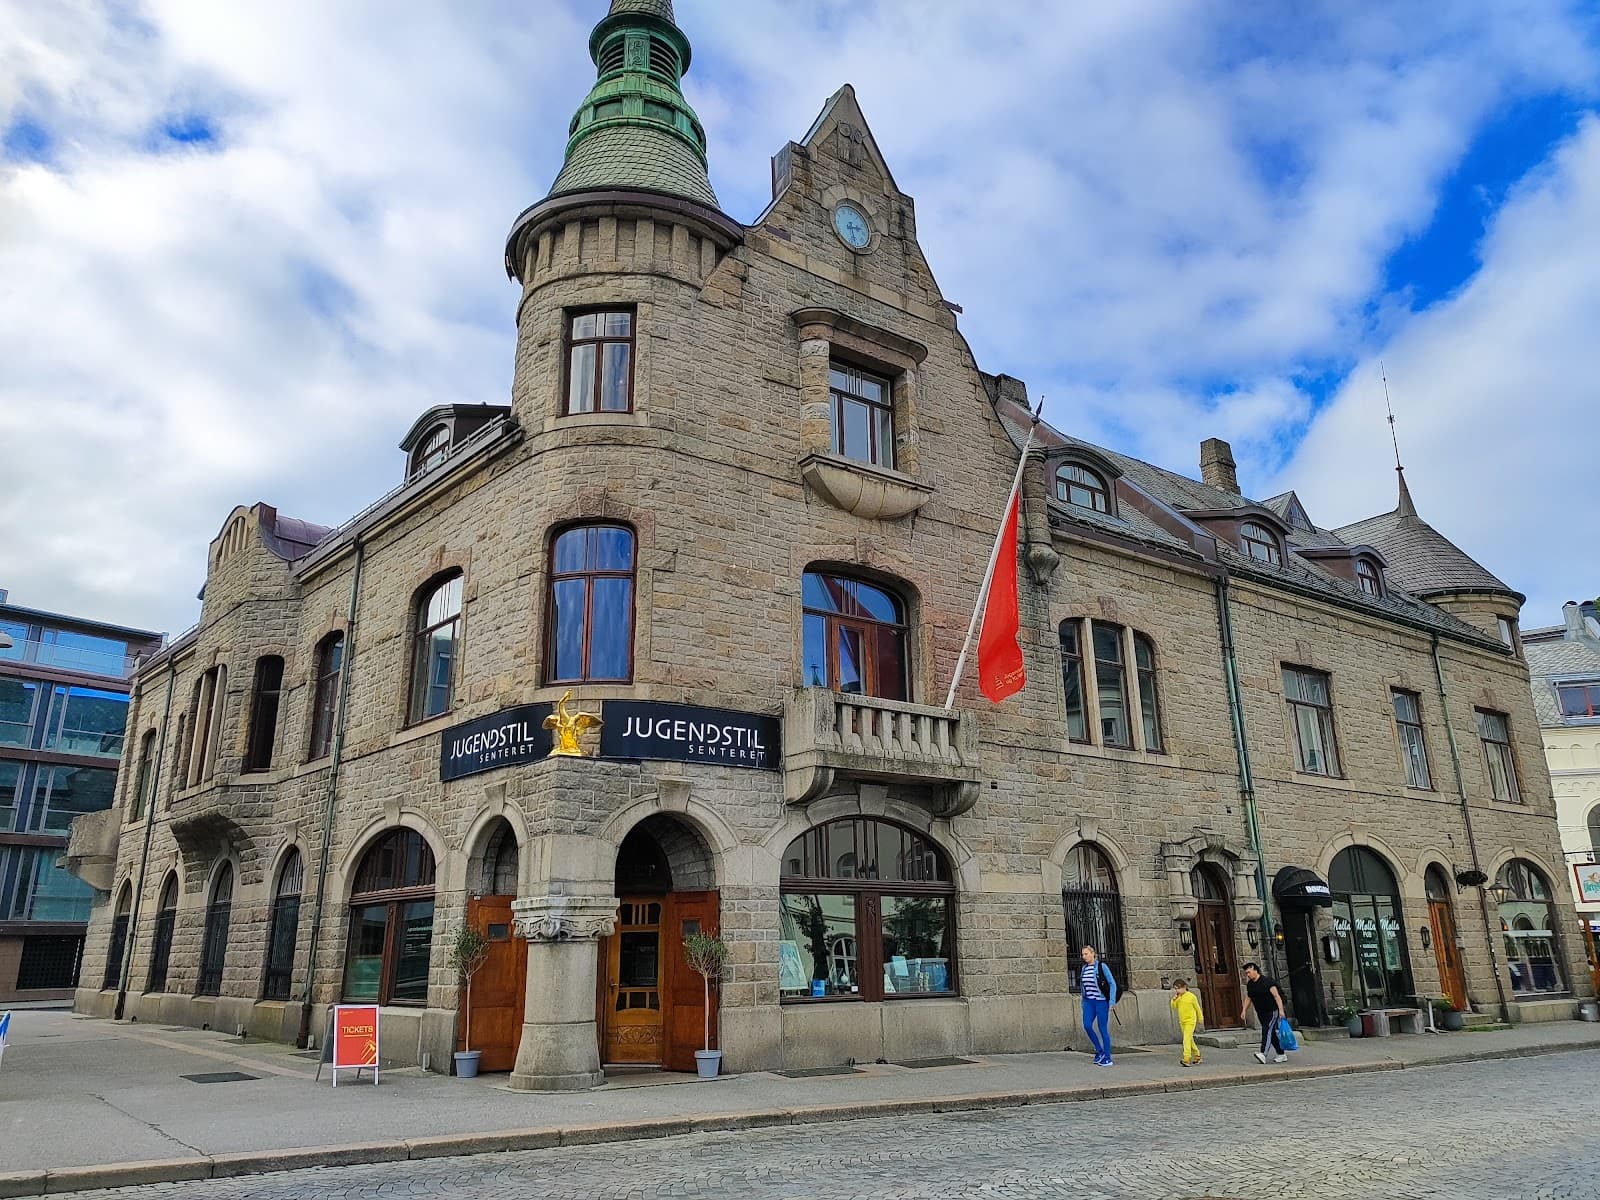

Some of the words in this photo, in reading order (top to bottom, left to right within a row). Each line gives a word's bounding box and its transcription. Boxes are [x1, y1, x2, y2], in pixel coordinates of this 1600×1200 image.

[450, 721, 534, 760] JUGENDSTIL
[622, 716, 765, 749] JUGENDSTIL
[479, 743, 534, 764] SENTERET
[688, 744, 765, 761] SENTERET
[342, 1025, 373, 1034] TICKETS
